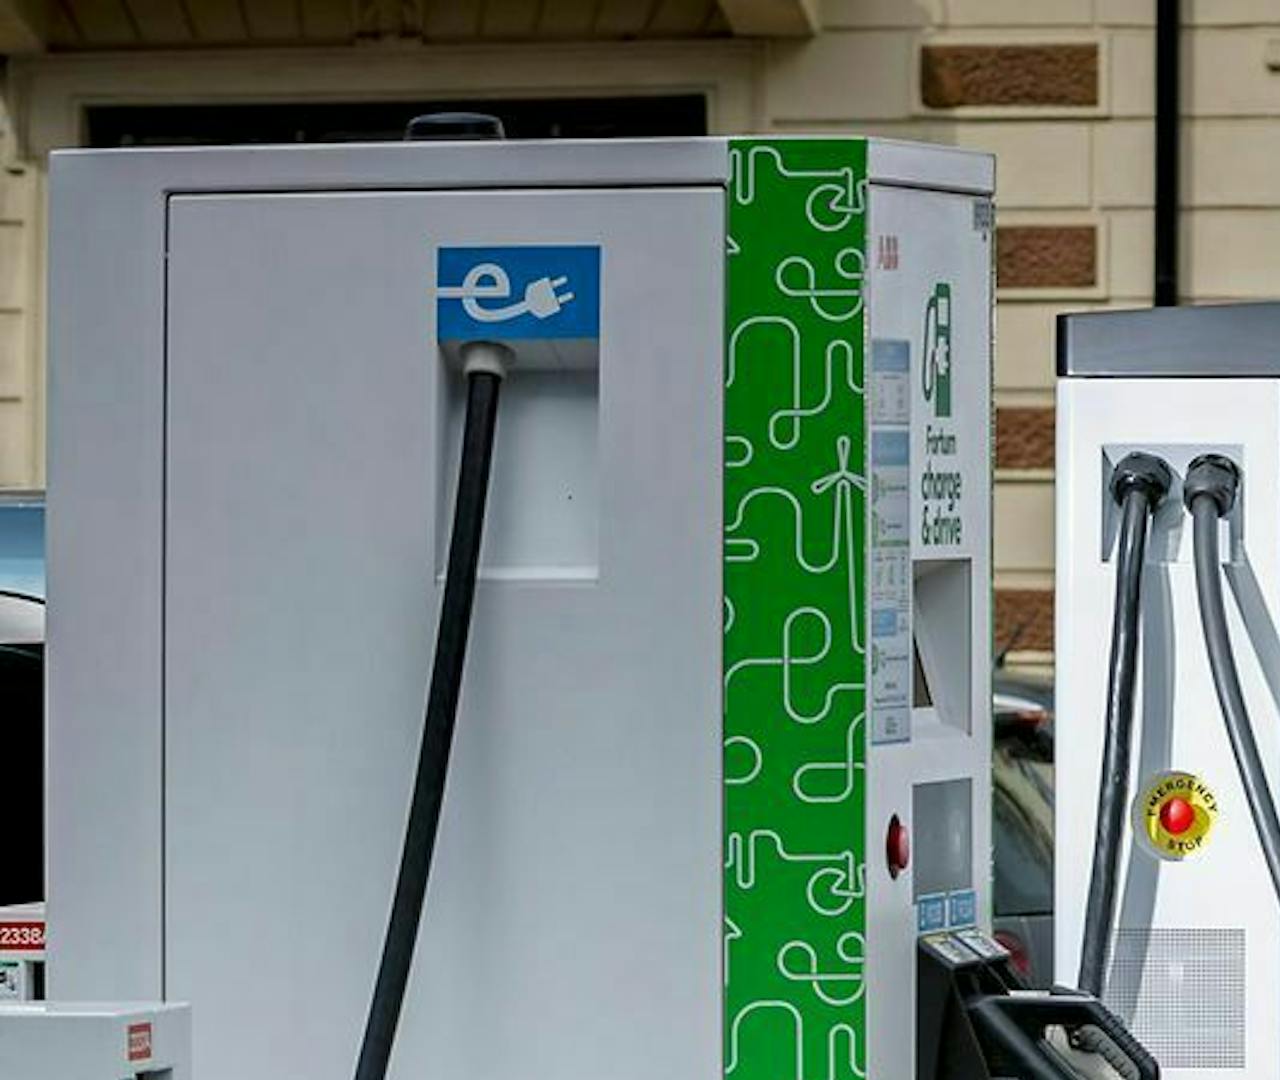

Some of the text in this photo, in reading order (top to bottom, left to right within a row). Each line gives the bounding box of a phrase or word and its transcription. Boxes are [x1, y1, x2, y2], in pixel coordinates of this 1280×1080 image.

[925, 424, 956, 454] Fortum
[921, 459, 961, 511] charge
[933, 505, 961, 546] drive
[1147, 779, 1217, 816] EMERGENCY
[1167, 836, 1203, 852] STOP
